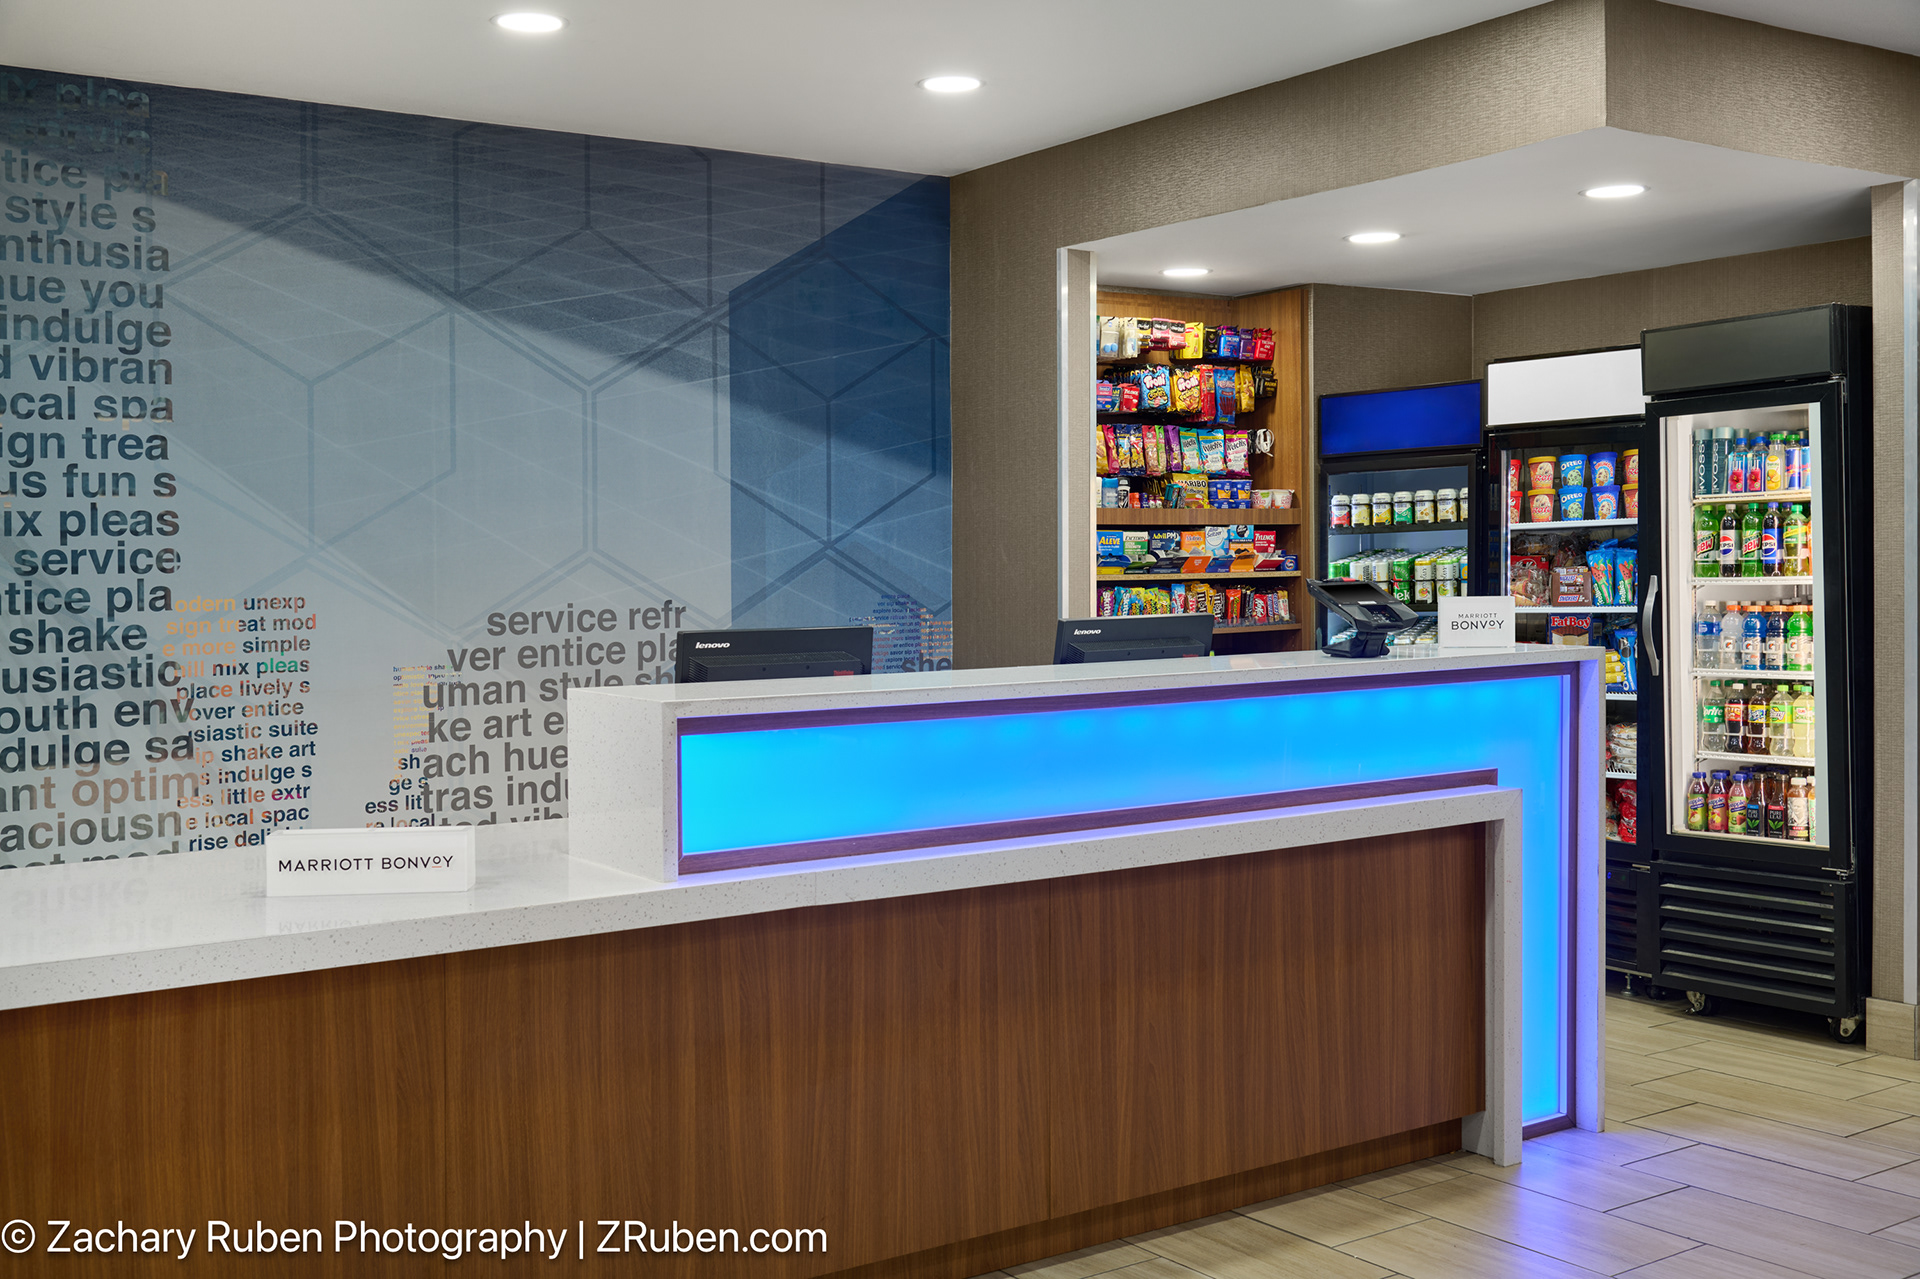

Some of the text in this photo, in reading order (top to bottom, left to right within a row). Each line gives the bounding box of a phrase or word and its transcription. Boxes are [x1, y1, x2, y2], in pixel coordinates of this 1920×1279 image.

[5, 193, 156, 235] style s
[0, 230, 170, 272] nthusia
[0, 275, 163, 314] ue you
[0, 304, 171, 355] indulge
[28, 346, 172, 384] vibran
[1144, 373, 1166, 389] Trolli
[0, 386, 174, 431] cal spa
[82, 427, 169, 460] trea
[1561, 460, 1583, 471] OREO
[62, 463, 136, 498] fun
[153, 472, 177, 498] s
[1561, 493, 1583, 503] OREO
[4, 502, 180, 546] ix pleas
[1099, 536, 1120, 545] ALEVE
[14, 540, 181, 576] service
[0, 578, 173, 622] tice pla
[175, 596, 306, 613] odern unexp
[166, 618, 212, 638] sign
[273, 613, 316, 631] mod
[487, 600, 686, 637] service refr
[1451, 620, 1504, 631] BONVOY
[1551, 616, 1591, 629] FatBoy
[9, 618, 147, 655] shake
[695, 641, 731, 649] lenovo
[1073, 628, 1101, 636] lenovo
[163, 636, 311, 657] e more simple
[447, 646, 506, 672] ver
[517, 636, 626, 669] entice
[2, 653, 182, 694] usiastic
[212, 659, 249, 676] mix
[257, 657, 310, 678] pleas
[176, 678, 311, 704] place lively s
[423, 680, 526, 709] uman
[0, 696, 195, 735] outh env
[189, 700, 304, 721] over entice
[268, 720, 318, 738] suite
[428, 712, 472, 743] ke
[483, 708, 532, 740] art
[543, 711, 564, 736] e
[0, 734, 194, 777] dulge sa
[221, 744, 283, 762] shake
[289, 741, 316, 757] art
[398, 753, 420, 770] sh
[423, 741, 568, 779] ach hue
[218, 764, 295, 785] indulge
[301, 764, 313, 778] s
[389, 778, 412, 796] ge
[72, 767, 199, 814] optim
[220, 787, 265, 806] little
[271, 783, 310, 801] extr
[420, 772, 568, 814] tras ind
[186, 806, 310, 830] e local spac
[365, 799, 398, 814] ess
[0, 811, 182, 852] aciousn
[189, 834, 228, 852] rise
[278, 856, 454, 872] MARRIOTT BONVOY
